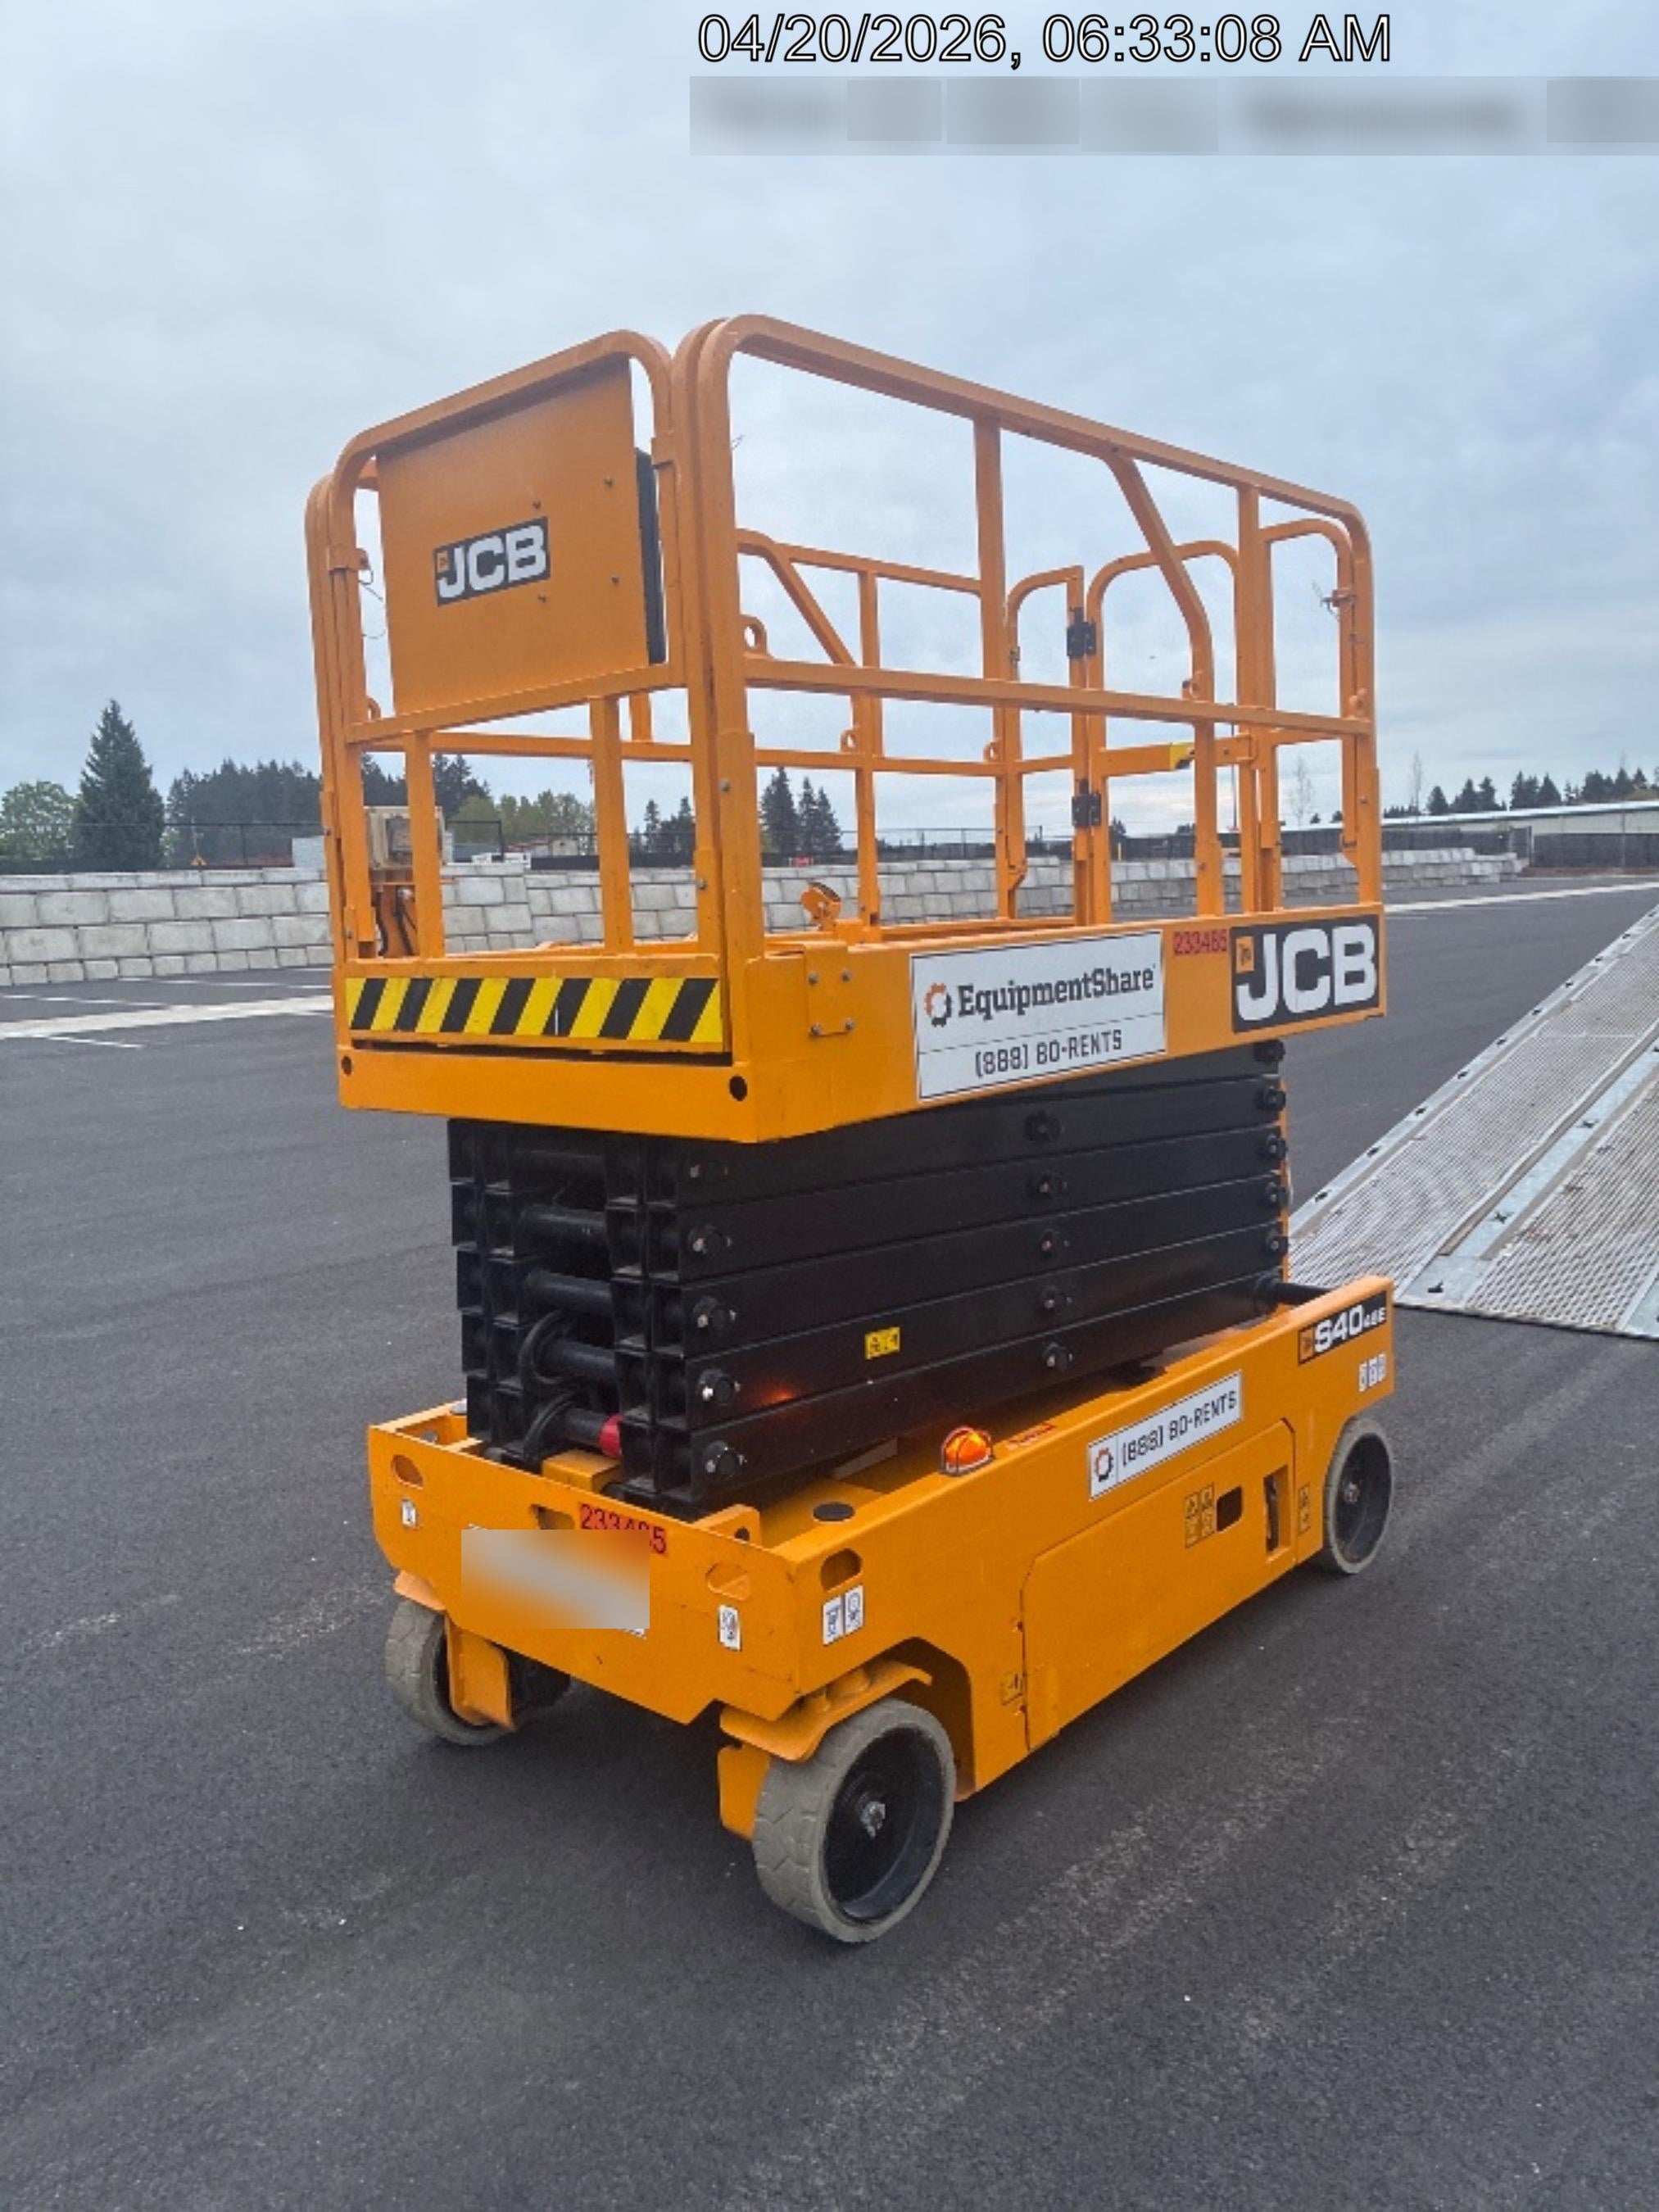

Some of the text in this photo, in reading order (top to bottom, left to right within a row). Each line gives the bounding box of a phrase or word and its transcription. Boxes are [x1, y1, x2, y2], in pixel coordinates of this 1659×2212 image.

[437, 524, 547, 599] JCB
[957, 967, 1154, 1021] EquipmentShare
[1235, 922, 1377, 1022] JCB
[975, 1043, 1029, 1078] (888)
[1122, 1425, 1164, 1467] (888)
